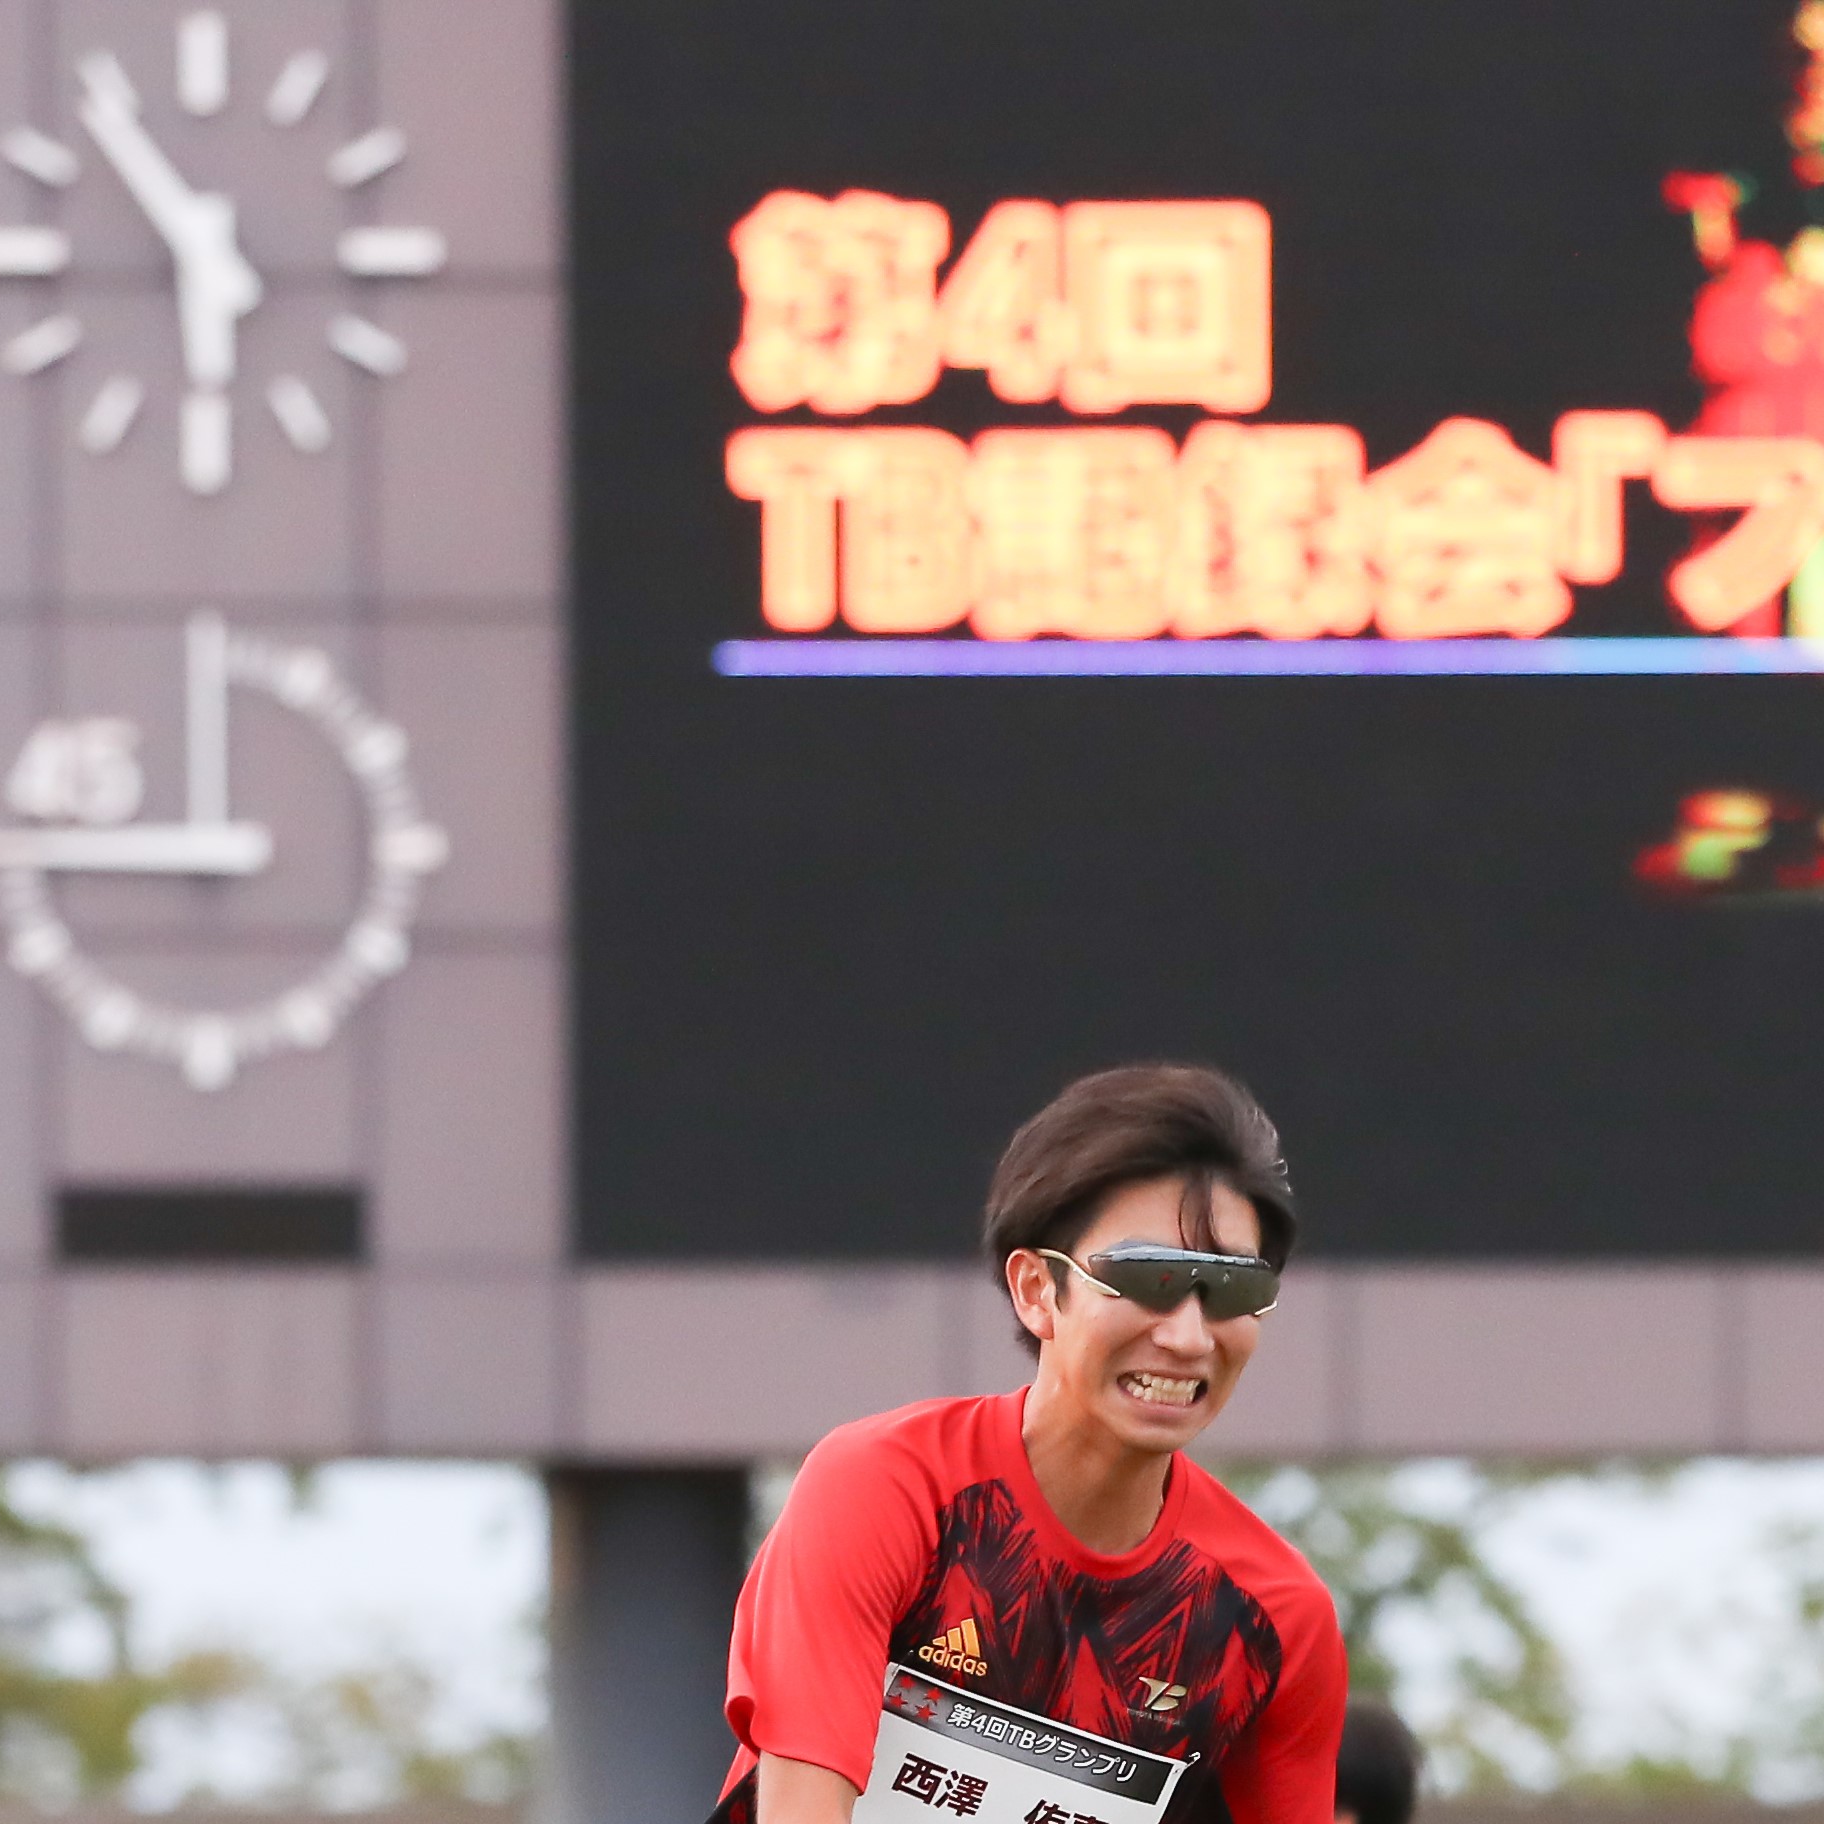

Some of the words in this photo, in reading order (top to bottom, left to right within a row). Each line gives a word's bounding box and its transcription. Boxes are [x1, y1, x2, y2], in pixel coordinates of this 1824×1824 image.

[732, 189, 1270, 413] 第4回
[918, 1645, 988, 1677] adidas
[946, 1702, 1140, 1784] 第4回TBグランプリ
[891, 1752, 990, 1819] 西澤
